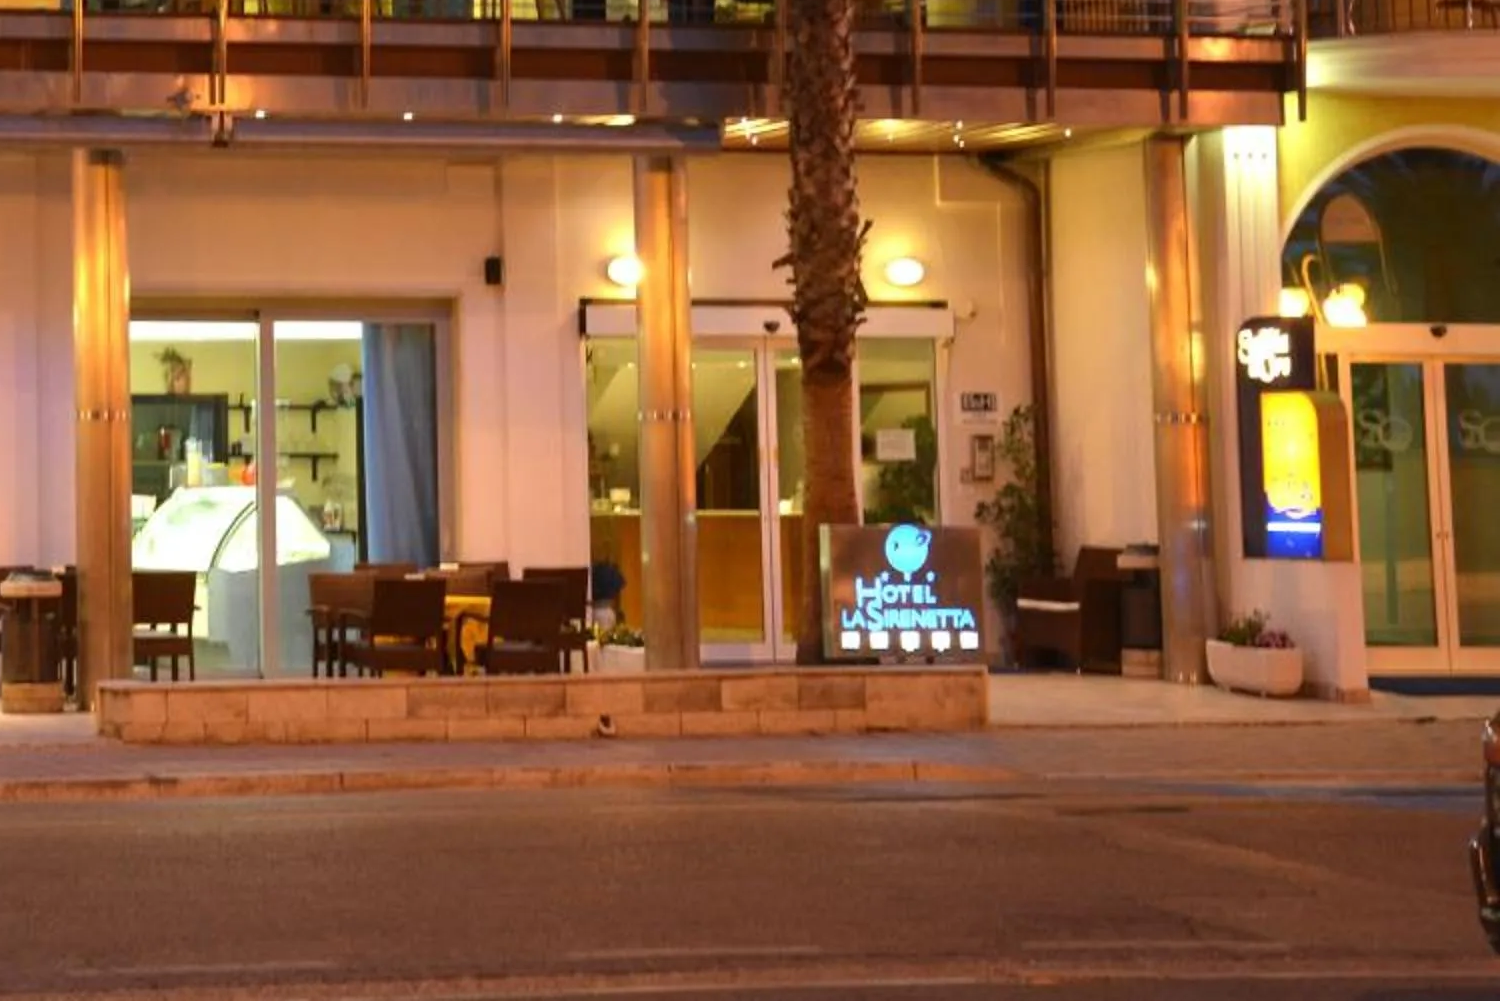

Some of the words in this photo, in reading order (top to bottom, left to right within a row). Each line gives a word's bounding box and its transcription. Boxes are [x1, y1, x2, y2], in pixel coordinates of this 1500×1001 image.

[855, 576, 938, 608] HOTEL
[841, 608, 866, 629] LA
[866, 601, 976, 632] SIRENETTA
